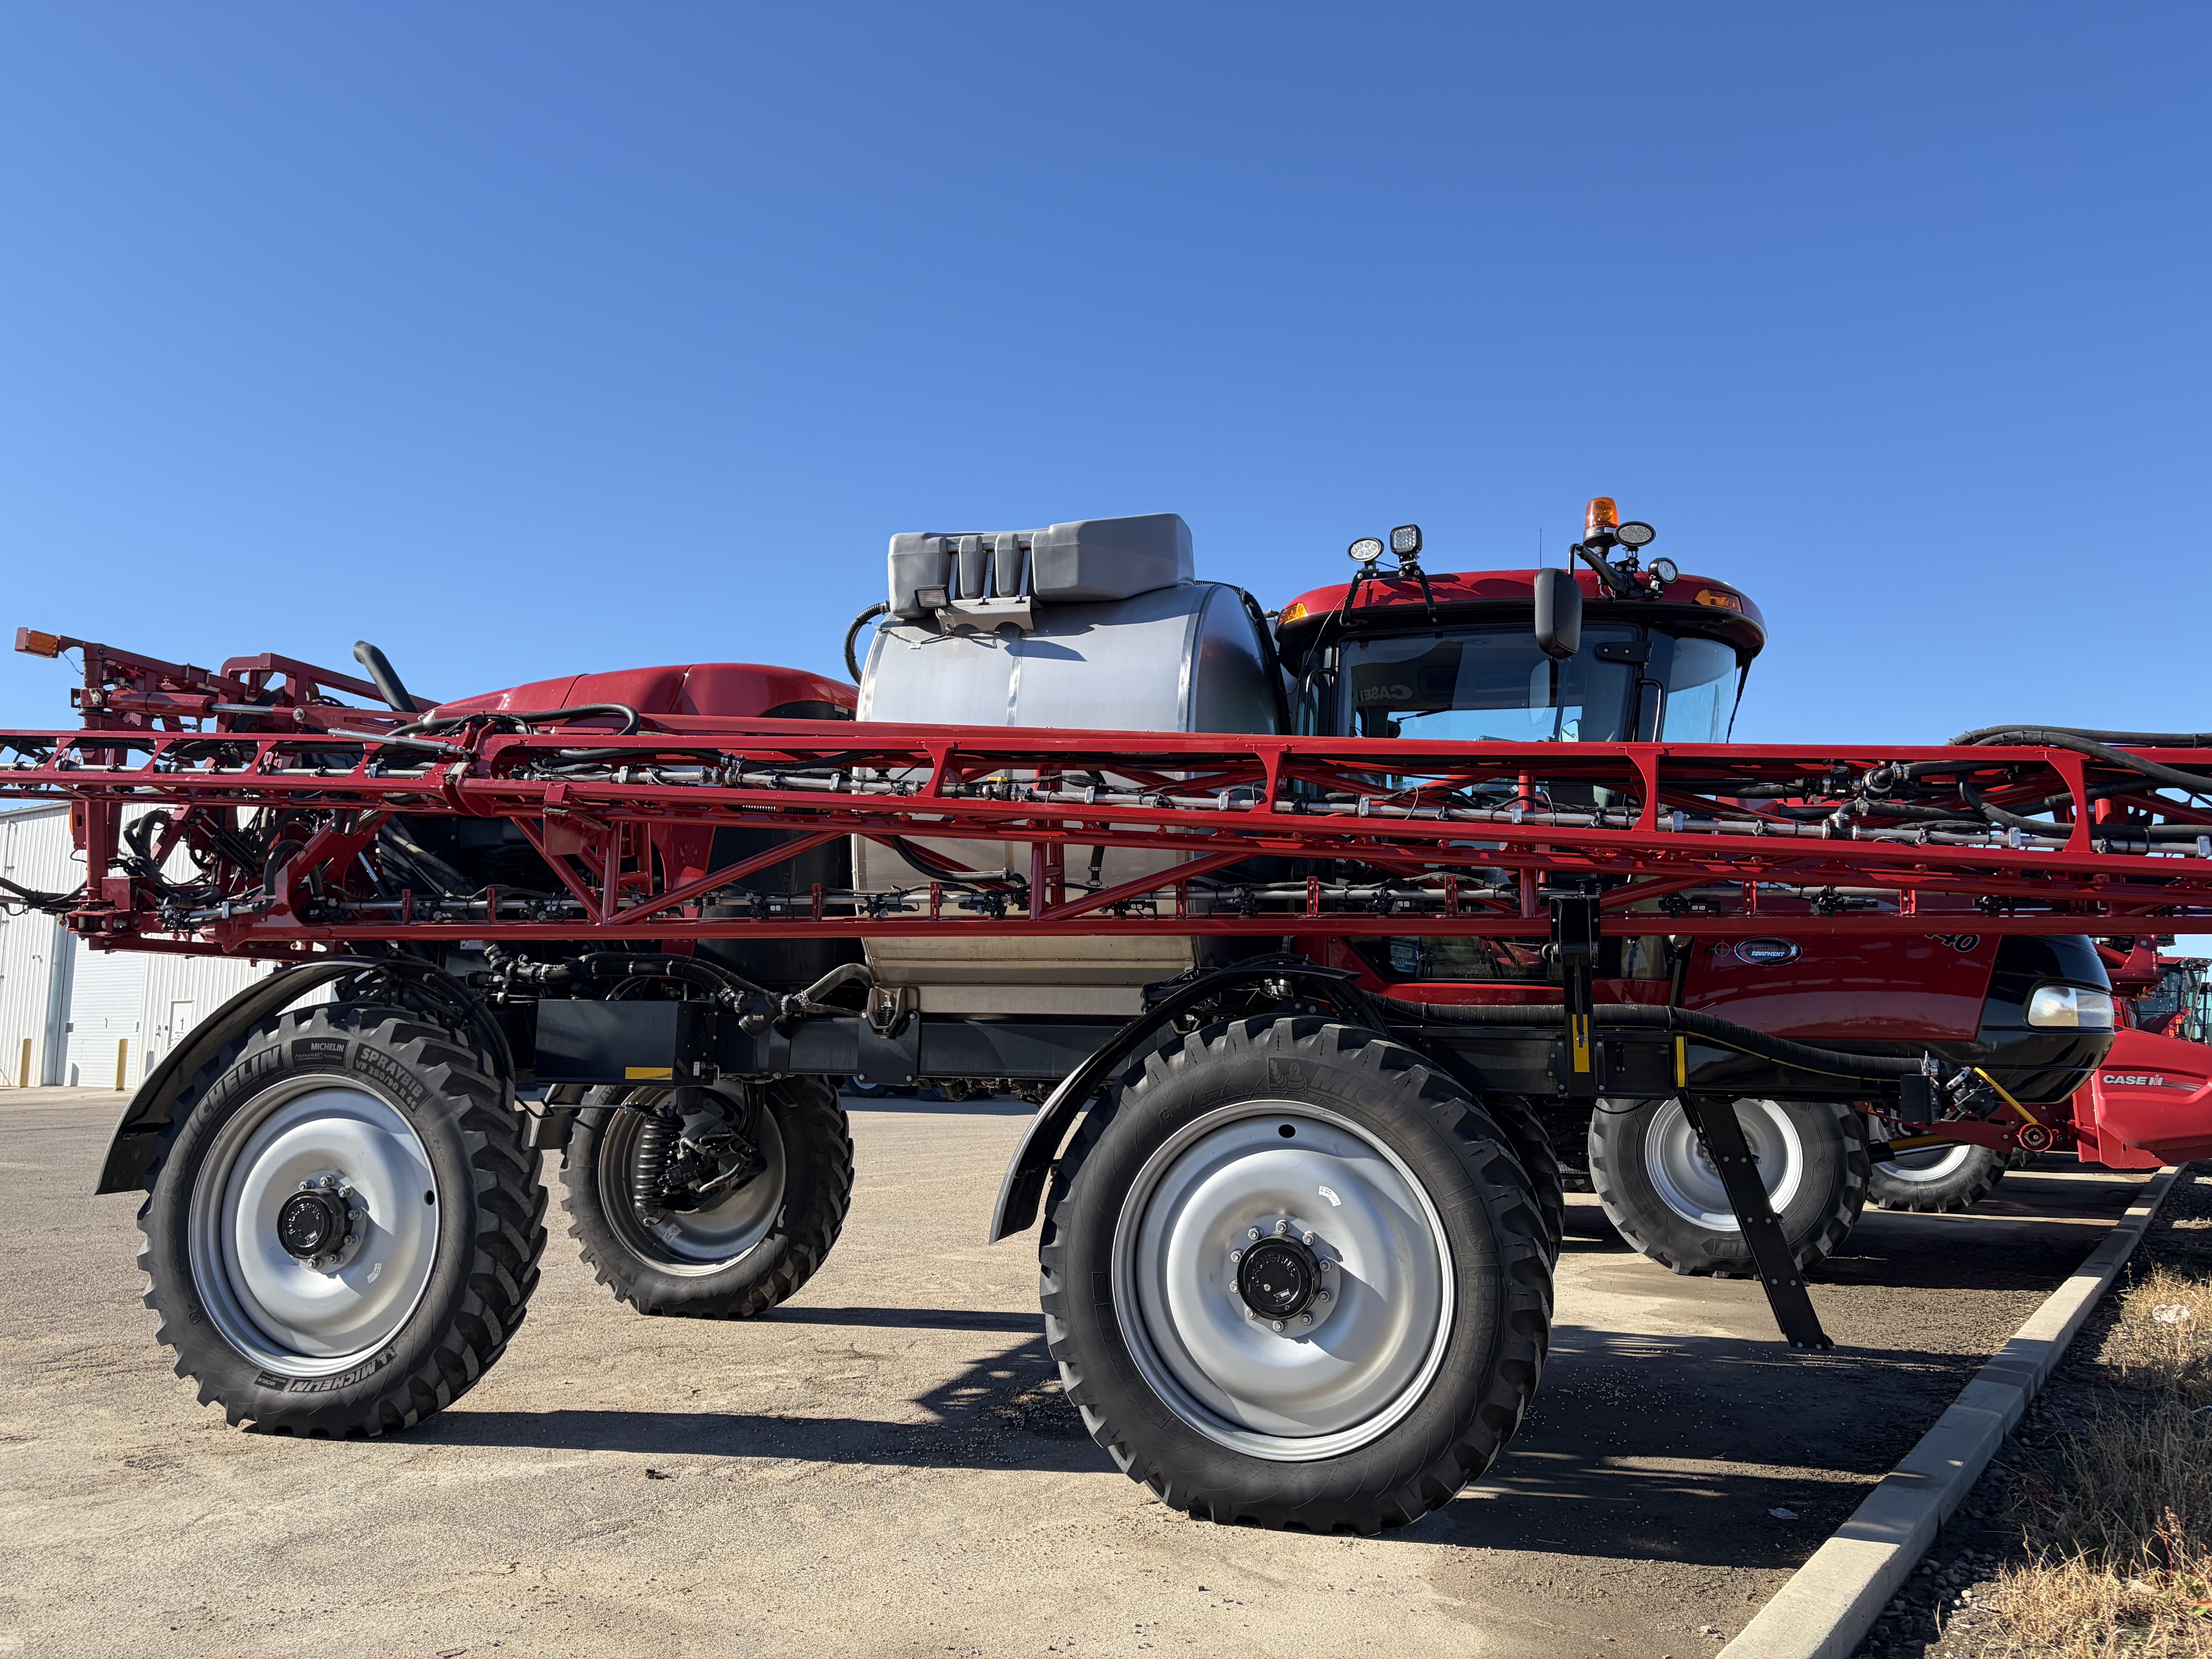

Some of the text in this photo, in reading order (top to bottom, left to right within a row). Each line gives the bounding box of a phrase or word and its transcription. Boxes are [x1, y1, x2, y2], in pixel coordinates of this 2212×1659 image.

[311, 1043, 344, 1052] MICHELIN
[356, 1060, 417, 1109] VF 380/90 R 46
[361, 1048, 423, 1097] SPRAYBIB
[2103, 1074, 2163, 1085] CASE IH
[174, 1046, 280, 1156] MICHELIN
[1462, 1209, 1479, 1245] ULTRAFLEX
[1469, 1274, 1497, 1376] SPRAYBIB
[290, 1360, 376, 1391] MICHELIN
